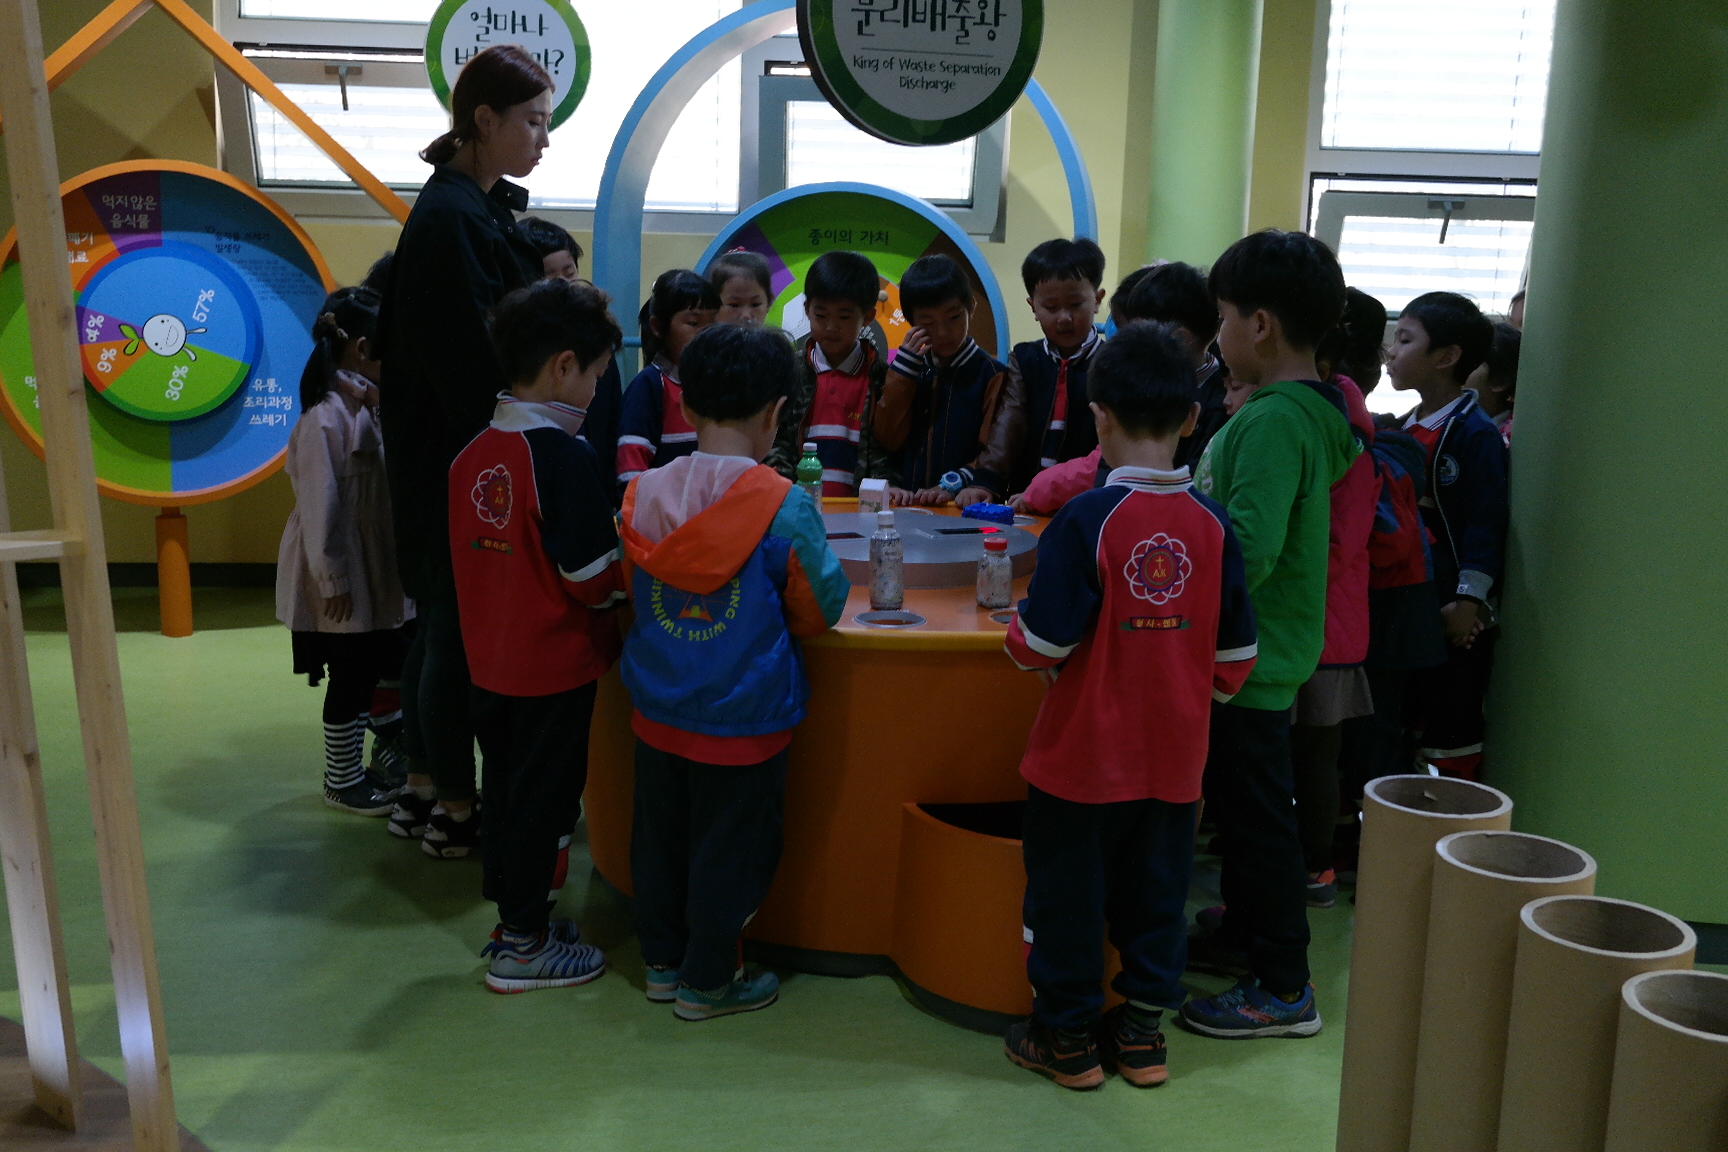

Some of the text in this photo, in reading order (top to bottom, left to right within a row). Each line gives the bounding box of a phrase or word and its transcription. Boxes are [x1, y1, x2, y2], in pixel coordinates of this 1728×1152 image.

[471, 6, 549, 42] 얼마나
[853, 55, 1001, 76] King of Waste Separation
[900, 76, 956, 93] Discharge
[109, 213, 151, 229] 음식물
[808, 228, 889, 246] 종이의 가치
[192, 289, 216, 323] 57%
[86, 314, 105, 342] 4%
[97, 348, 118, 373] 9%
[165, 365, 189, 401] 30%
[252, 378, 283, 393] 유통,
[249, 413, 287, 426] 쓰레기
[688, 621, 727, 641] WITH
